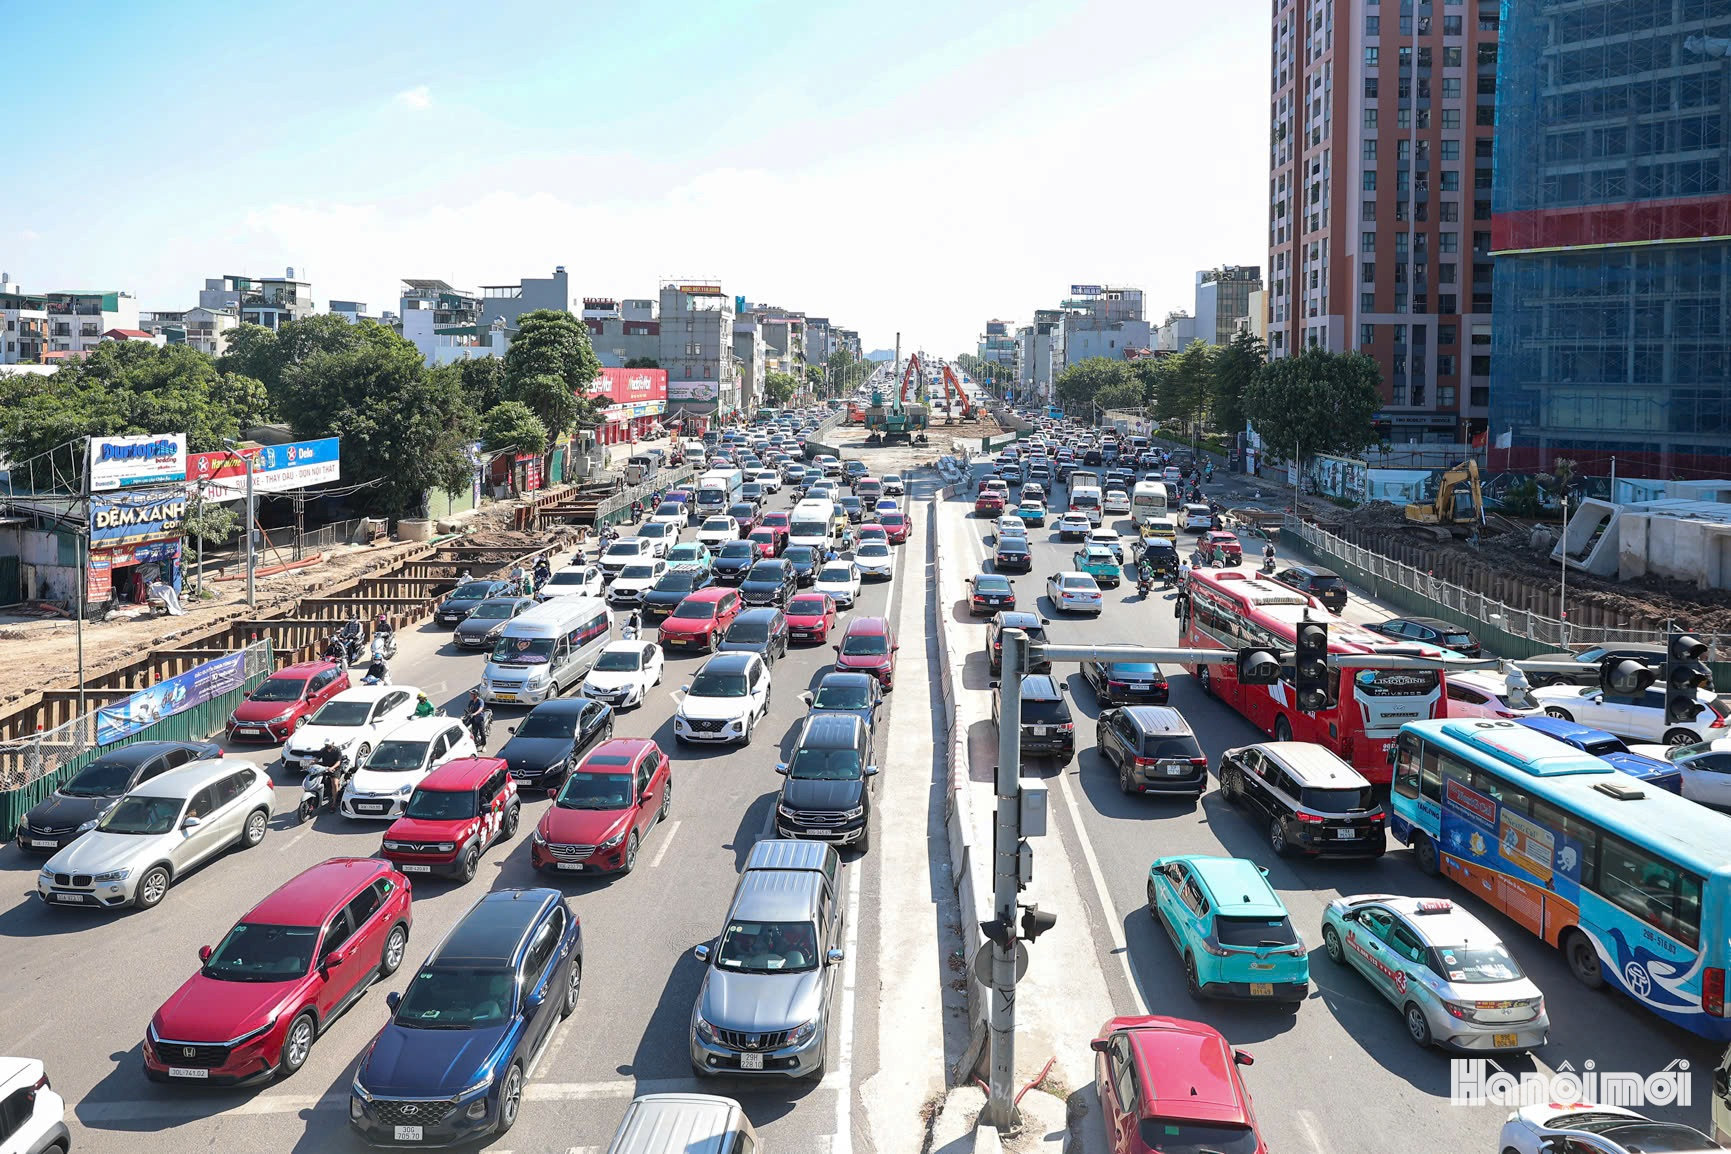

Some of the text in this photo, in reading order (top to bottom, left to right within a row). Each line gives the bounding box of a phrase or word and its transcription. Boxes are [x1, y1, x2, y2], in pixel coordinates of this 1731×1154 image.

[298, 448, 313, 459] Delo
[266, 474, 281, 484] THAY
[208, 486, 228, 499] HUY
[96, 502, 185, 528] ĐỆM XANH
[746, 1053, 758, 1061] 29H
